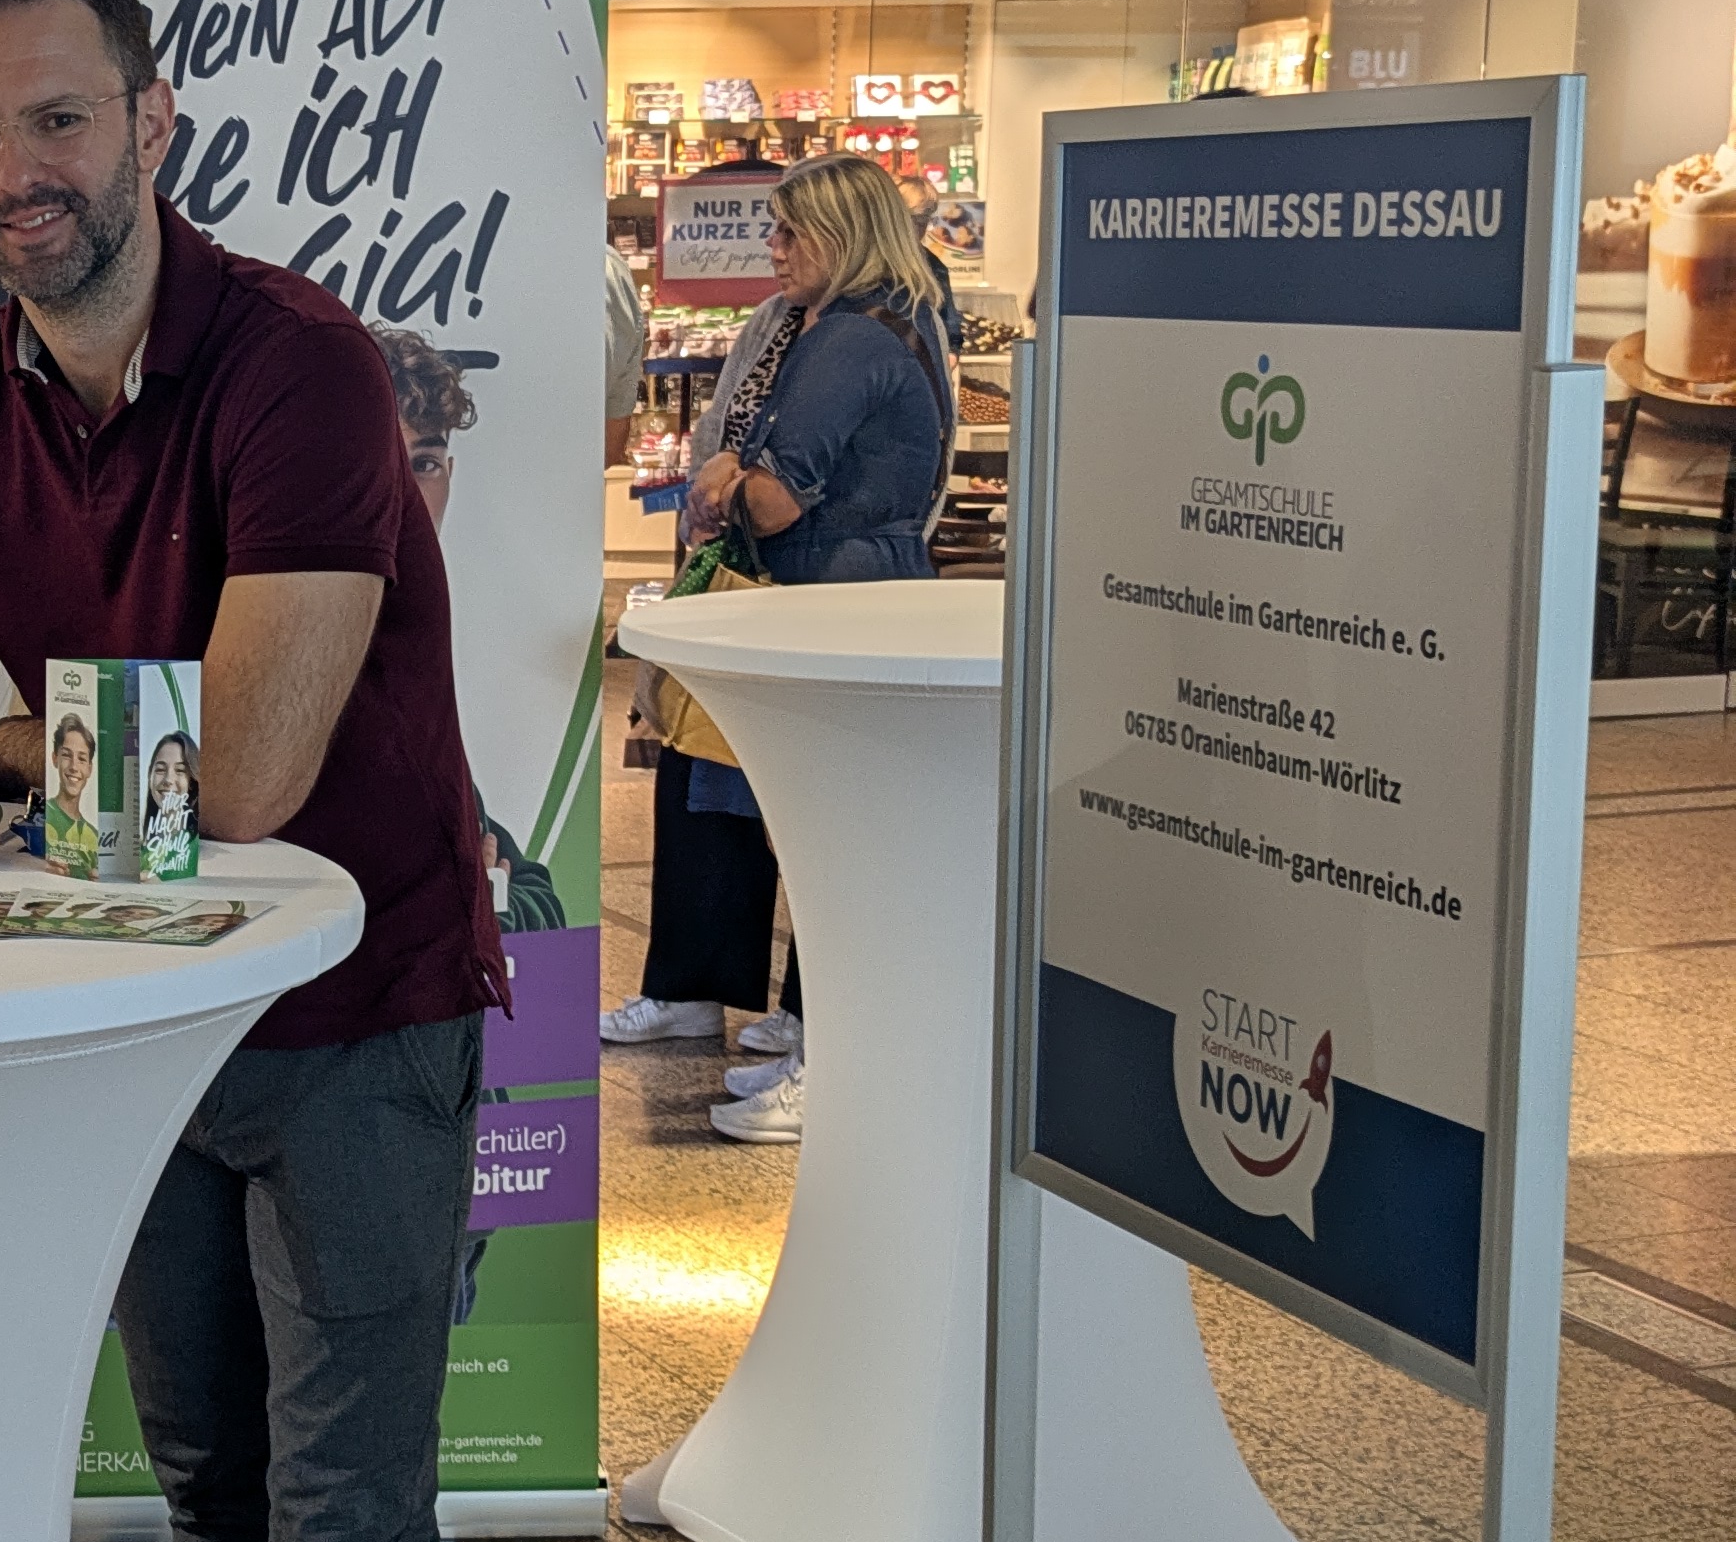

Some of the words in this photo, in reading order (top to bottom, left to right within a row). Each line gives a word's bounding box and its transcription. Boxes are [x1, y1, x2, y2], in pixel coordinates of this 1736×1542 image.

[672, 222, 749, 241] KURZE
[694, 200, 742, 218] NUR
[1089, 192, 1342, 239] KARRIEREMESSE
[1352, 187, 1503, 239] DESSAU
[1191, 476, 1334, 519] GESAMTSCHULE
[1181, 504, 1200, 531] IM
[1205, 508, 1344, 552] GARTENREICH
[1103, 572, 1224, 621] Gesamtschule
[1227, 594, 1254, 628] im
[1258, 602, 1386, 652] Gartenreich
[1391, 630, 1413, 656] e.
[1420, 629, 1445, 661] G.
[1177, 677, 1306, 731] Marienstraße
[1309, 708, 1335, 739] 42
[1125, 709, 1177, 746] 06785
[1181, 724, 1402, 805] Oranienbaum-Wörlitz
[147, 809, 193, 840] MACHT
[1079, 788, 1463, 921] www.gesamtschule-im-gartenreich.de
[1201, 988, 1297, 1061] START
[1201, 1033, 1294, 1086] Karrieremesse
[1200, 1059, 1292, 1141] NOW
[476, 1123, 566, 1155] chüler)
[472, 1164, 551, 1196] bitur
[447, 1359, 484, 1373] reich
[487, 1358, 510, 1373] eG
[438, 1434, 543, 1450] m-gartenreich.de
[438, 1450, 518, 1464] artenreich.de
